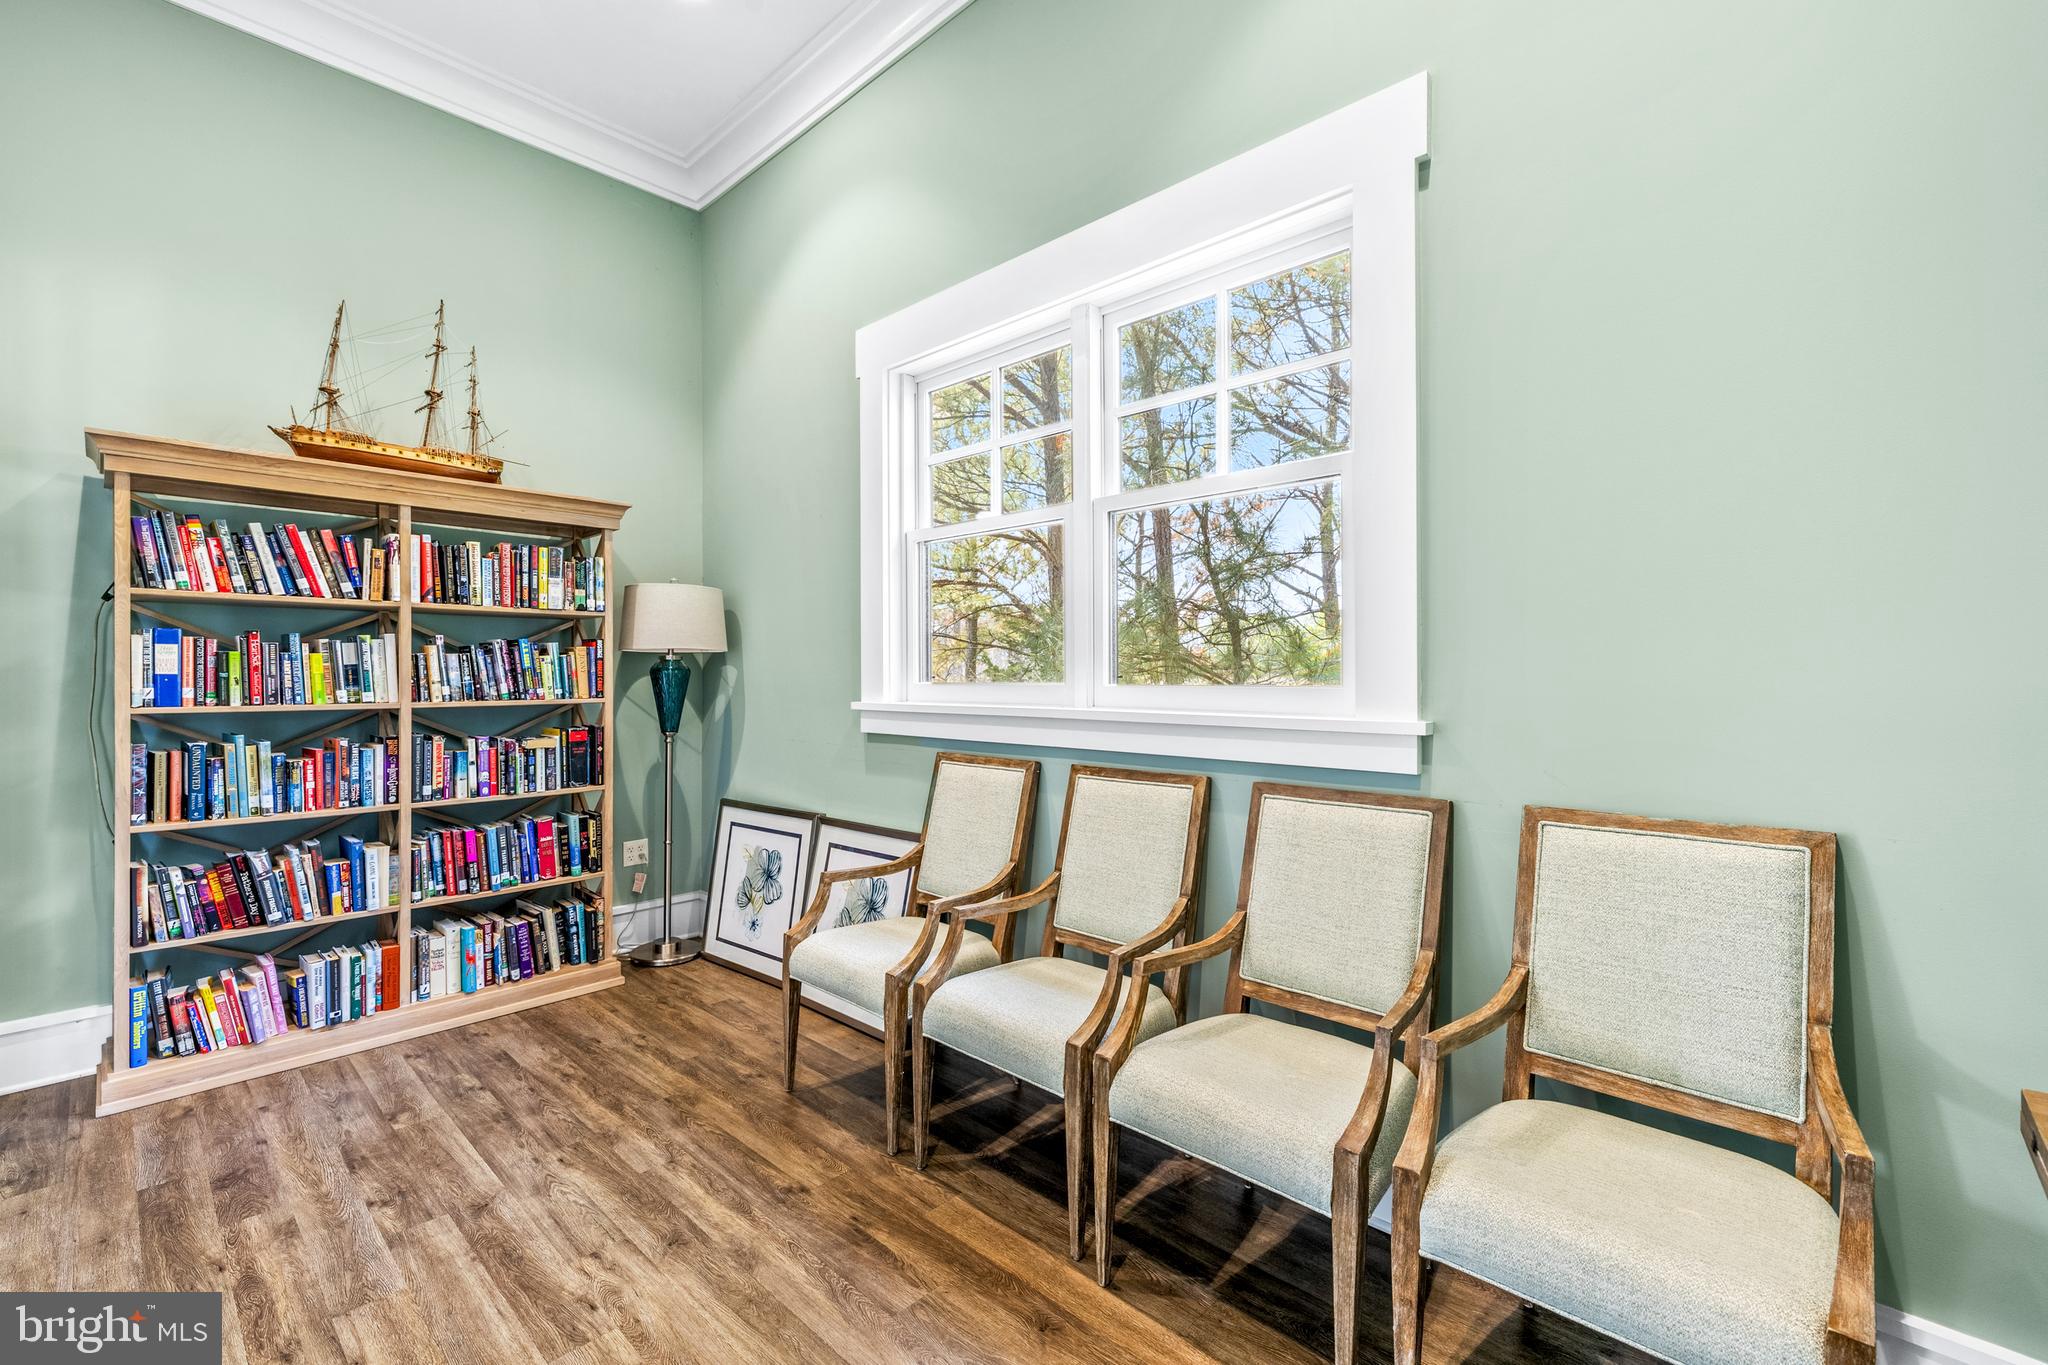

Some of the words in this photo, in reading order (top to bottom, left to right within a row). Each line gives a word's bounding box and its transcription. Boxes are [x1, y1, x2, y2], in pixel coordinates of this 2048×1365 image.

[351, 745, 360, 766] LAWRENCE
[435, 743, 443, 766] MISSION
[191, 746, 202, 790] UNDAUNTED
[351, 766, 360, 780] BLOCK
[364, 779, 373, 801] NEMESIS
[239, 871, 256, 902] Father's
[262, 879, 275, 898] JONATHAN
[247, 902, 260, 916] Day
[152, 980, 163, 995] TERRY
[132, 990, 147, 1018] Griffin
[132, 1020, 145, 1050] Shooters
